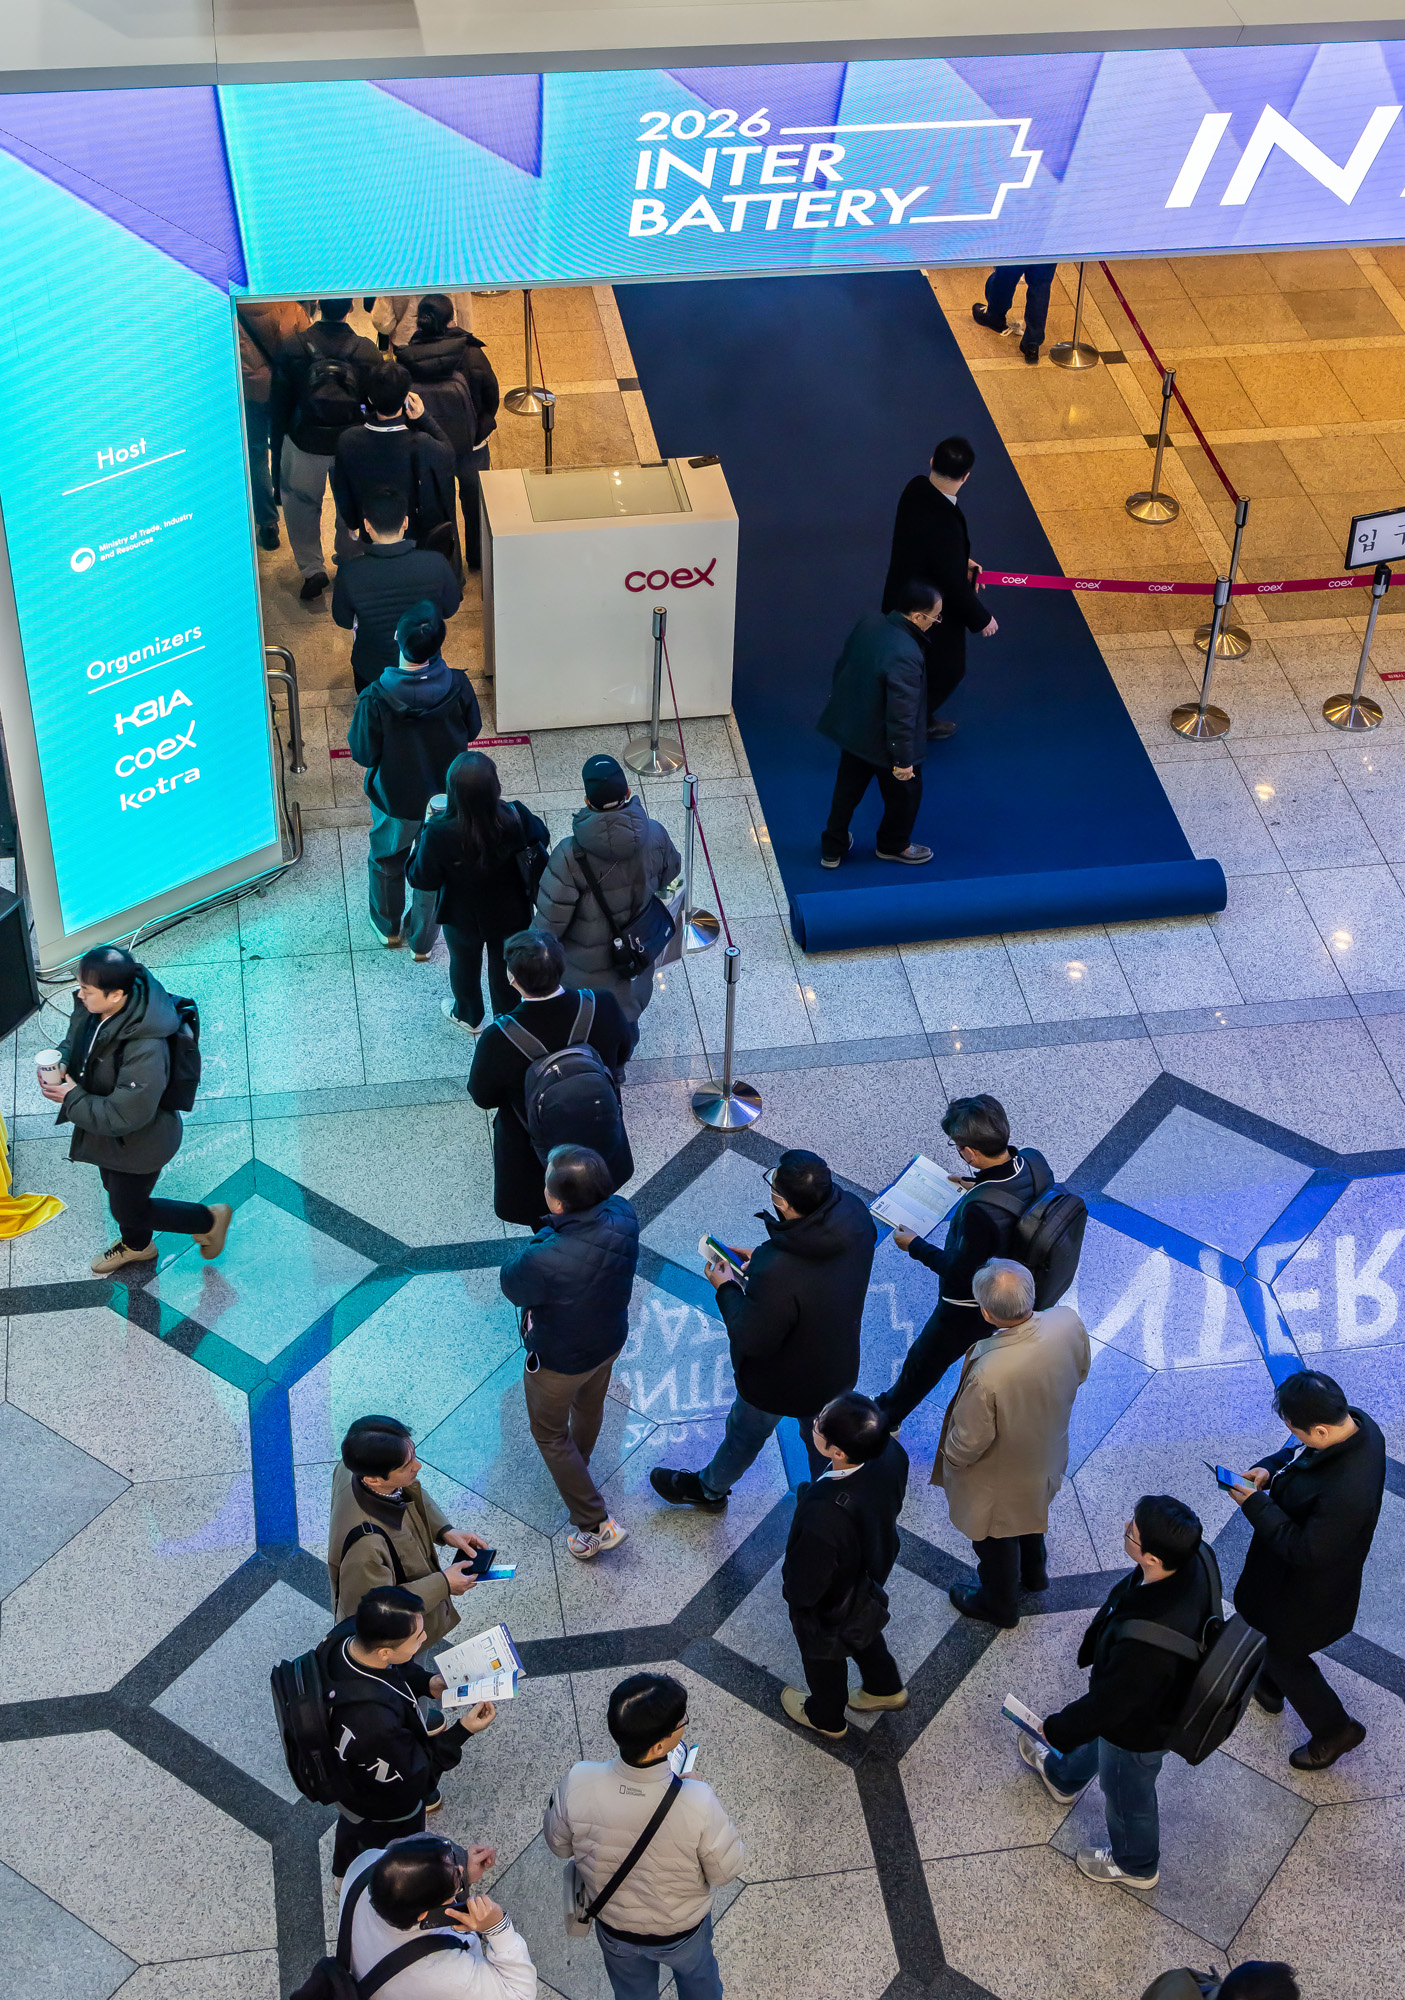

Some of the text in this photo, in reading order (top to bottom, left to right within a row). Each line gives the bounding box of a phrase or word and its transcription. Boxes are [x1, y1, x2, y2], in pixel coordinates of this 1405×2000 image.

[636, 107, 772, 141] 2026
[635, 143, 846, 190] INTER
[1164, 103, 1405, 209] IN
[628, 186, 930, 237] BATTERY
[97, 437, 147, 470] Host
[98, 536, 129, 552] Ministry
[129, 532, 137, 541] of
[163, 512, 193, 528] Industry
[100, 537, 154, 562] and Resources
[624, 557, 717, 593] coex
[1001, 575, 1355, 593] coex coex coex coex coex
[86, 625, 202, 680] Organizers
[115, 719, 197, 778] coex
[119, 767, 201, 812] kotra
